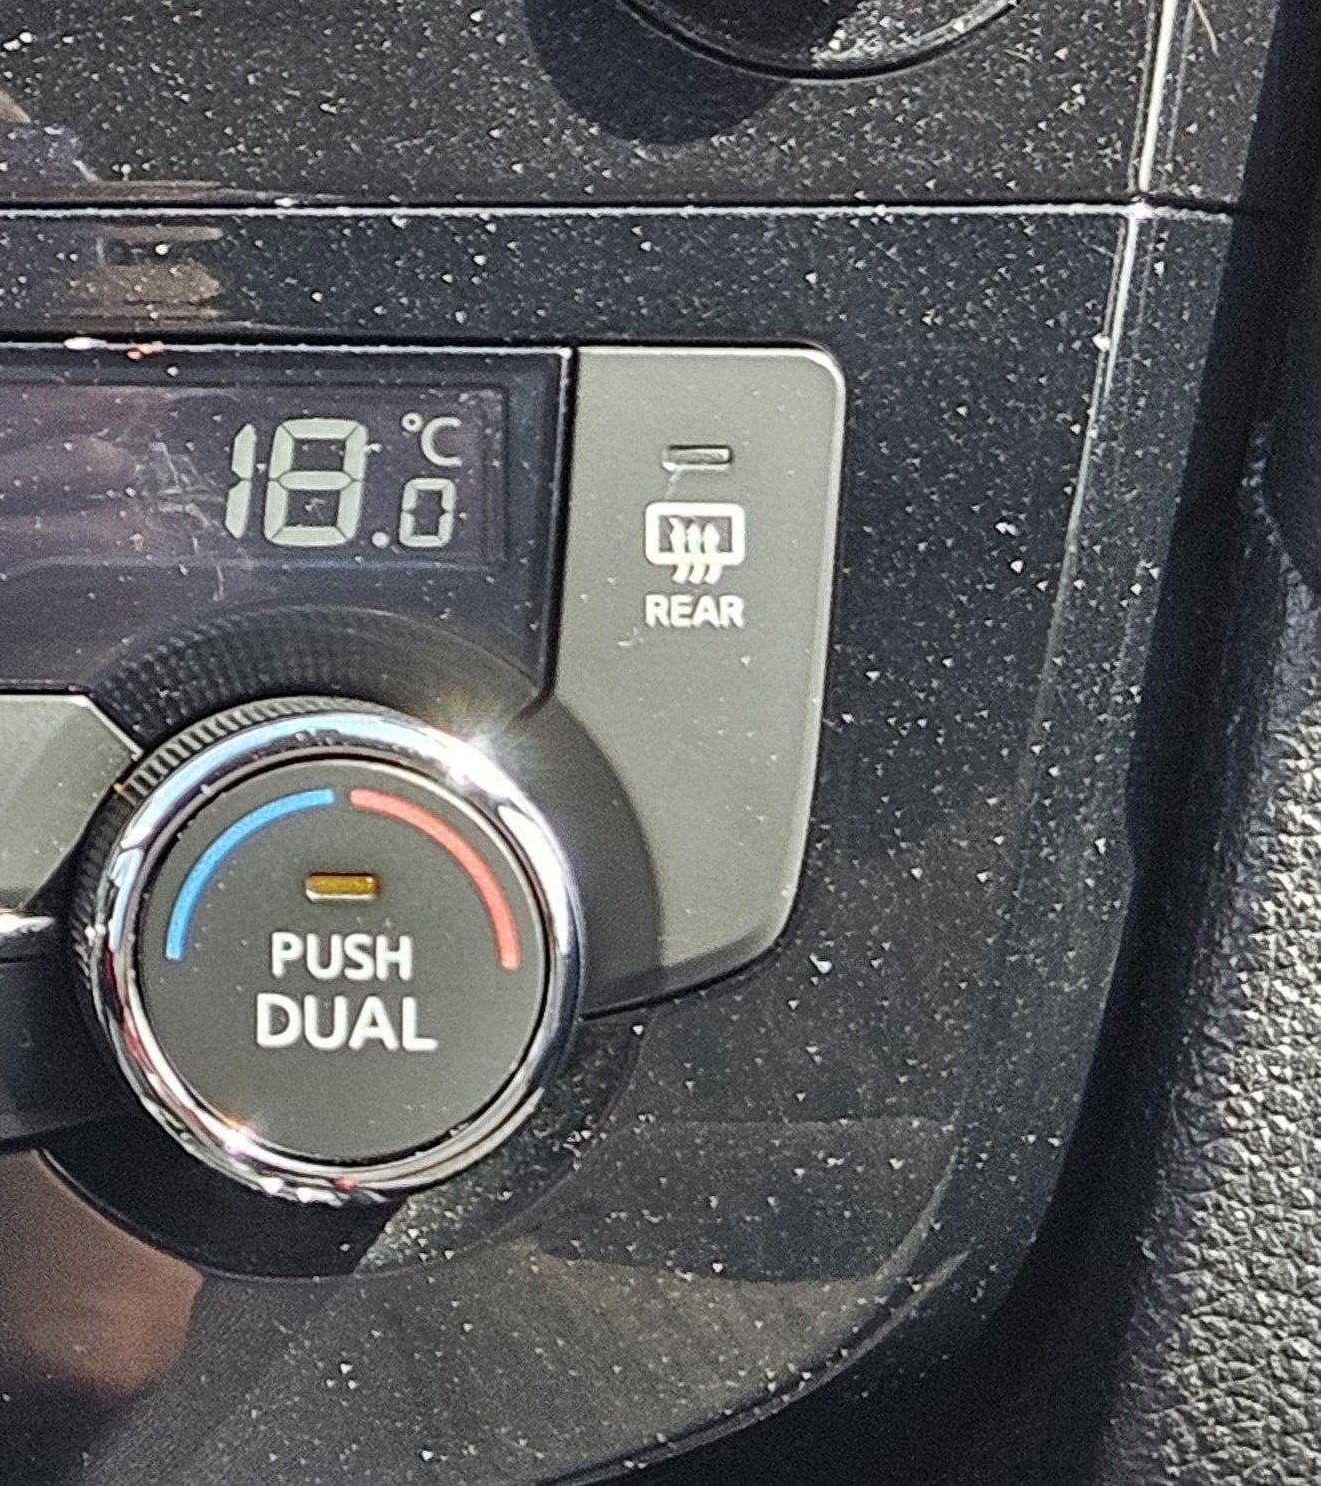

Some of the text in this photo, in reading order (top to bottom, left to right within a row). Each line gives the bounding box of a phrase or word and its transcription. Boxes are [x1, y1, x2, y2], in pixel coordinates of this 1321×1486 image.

[645, 593, 745, 628] REAR
[270, 931, 413, 981] PUSH
[256, 992, 439, 1052] DUAL
